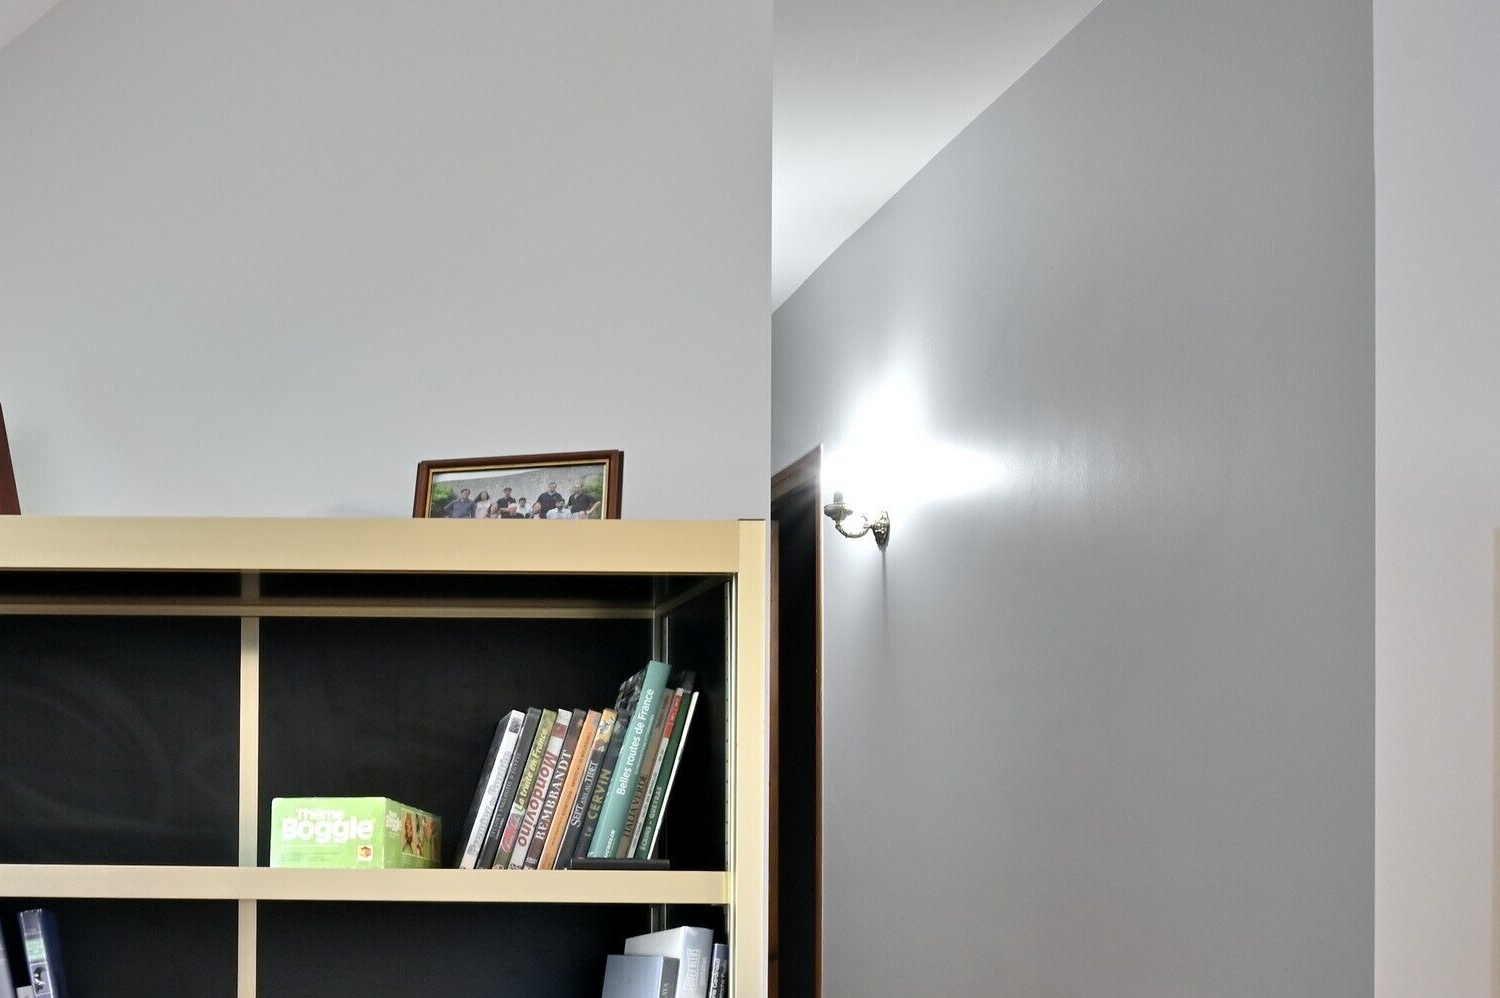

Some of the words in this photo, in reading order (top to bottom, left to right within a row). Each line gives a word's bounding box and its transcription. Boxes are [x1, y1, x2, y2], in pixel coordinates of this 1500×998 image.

[531, 728, 548, 759] France
[615, 766, 633, 795] Belles
[627, 735, 641, 766] routes
[634, 722, 644, 735] de
[639, 689, 655, 722] France
[529, 760, 538, 771] en
[516, 749, 557, 849] Mondovino
[519, 772, 534, 796] truite
[534, 748, 572, 841] REMBRANDT
[569, 803, 586, 827] SEPT
[583, 760, 599, 784] TIBET
[588, 768, 612, 820] CERVIN
[514, 796, 525, 810] La
[647, 785, 663, 818] QUEYRAS
[282, 816, 374, 844] Boggle
[622, 807, 638, 837] ITALIA
